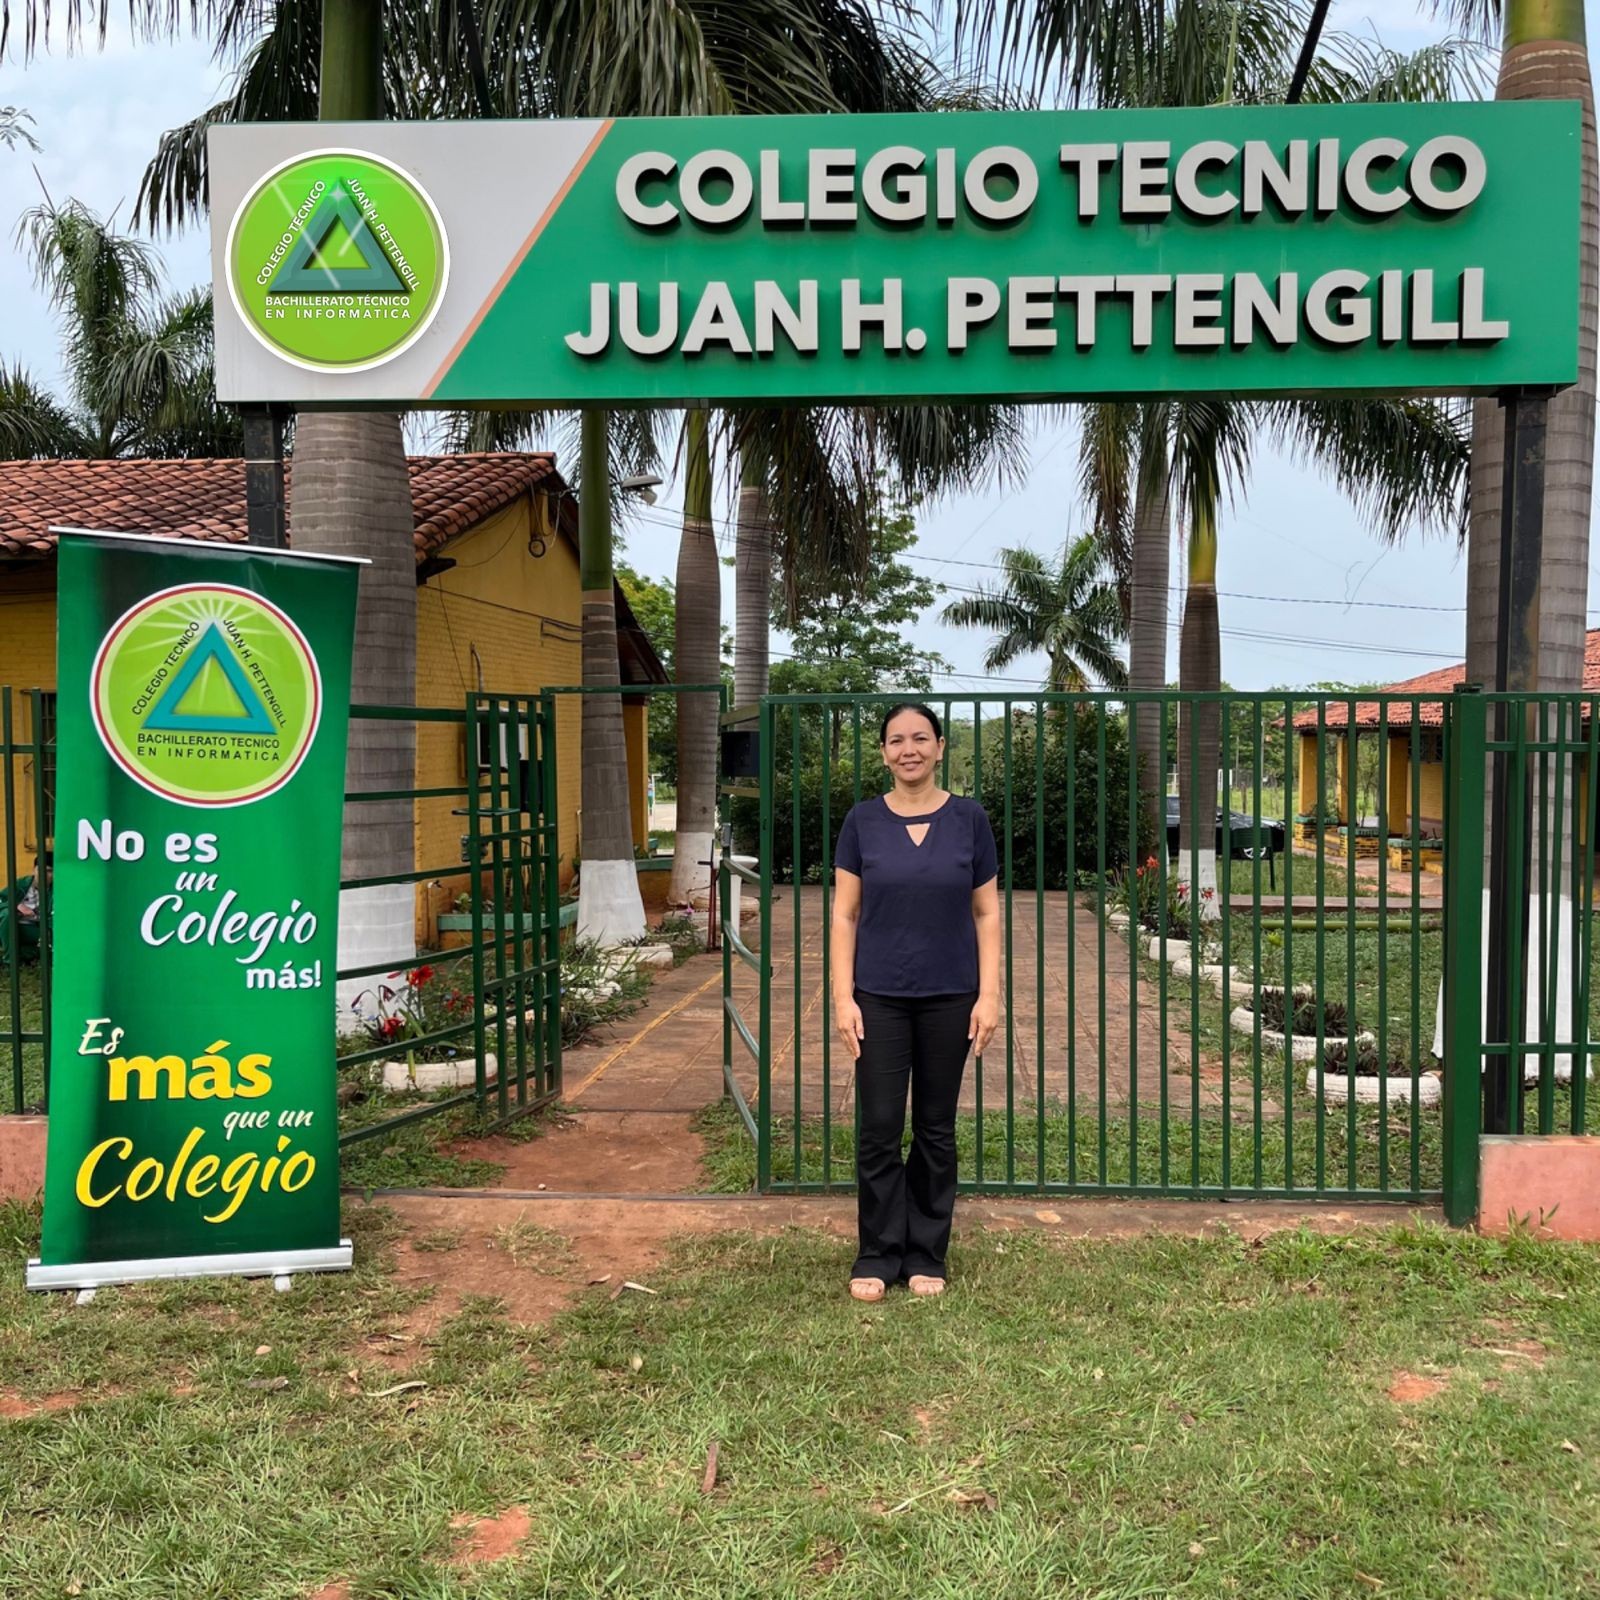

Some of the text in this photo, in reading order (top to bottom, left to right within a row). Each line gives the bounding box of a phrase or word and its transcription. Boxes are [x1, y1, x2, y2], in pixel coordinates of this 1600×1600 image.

[615, 135, 1487, 228] COLEGIO TECNICO
[256, 180, 326, 285] COLEGIO TECNICO
[347, 178, 420, 292] JUAN H. PETTENGILL
[265, 294, 410, 307] BACHILLERATO TÉCNICO
[265, 309, 411, 319] EN INFORMATICA
[564, 267, 1509, 356] JUAN H. PETTENGILL
[131, 622, 199, 716] COLEGIO TECNICO
[223, 619, 287, 728] JUAN H. PETTENGILL
[137, 733, 280, 749] BACHILLERATO TECNICO
[137, 747, 280, 761] EN INFORMATICA
[77, 818, 219, 863] No es
[175, 871, 219, 892] un
[140, 889, 317, 964] Colegio
[246, 959, 322, 989] más!
[78, 1017, 125, 1056] Es
[108, 1039, 273, 1102] más
[223, 1109, 314, 1141] que un
[75, 1126, 316, 1224] Colegio
